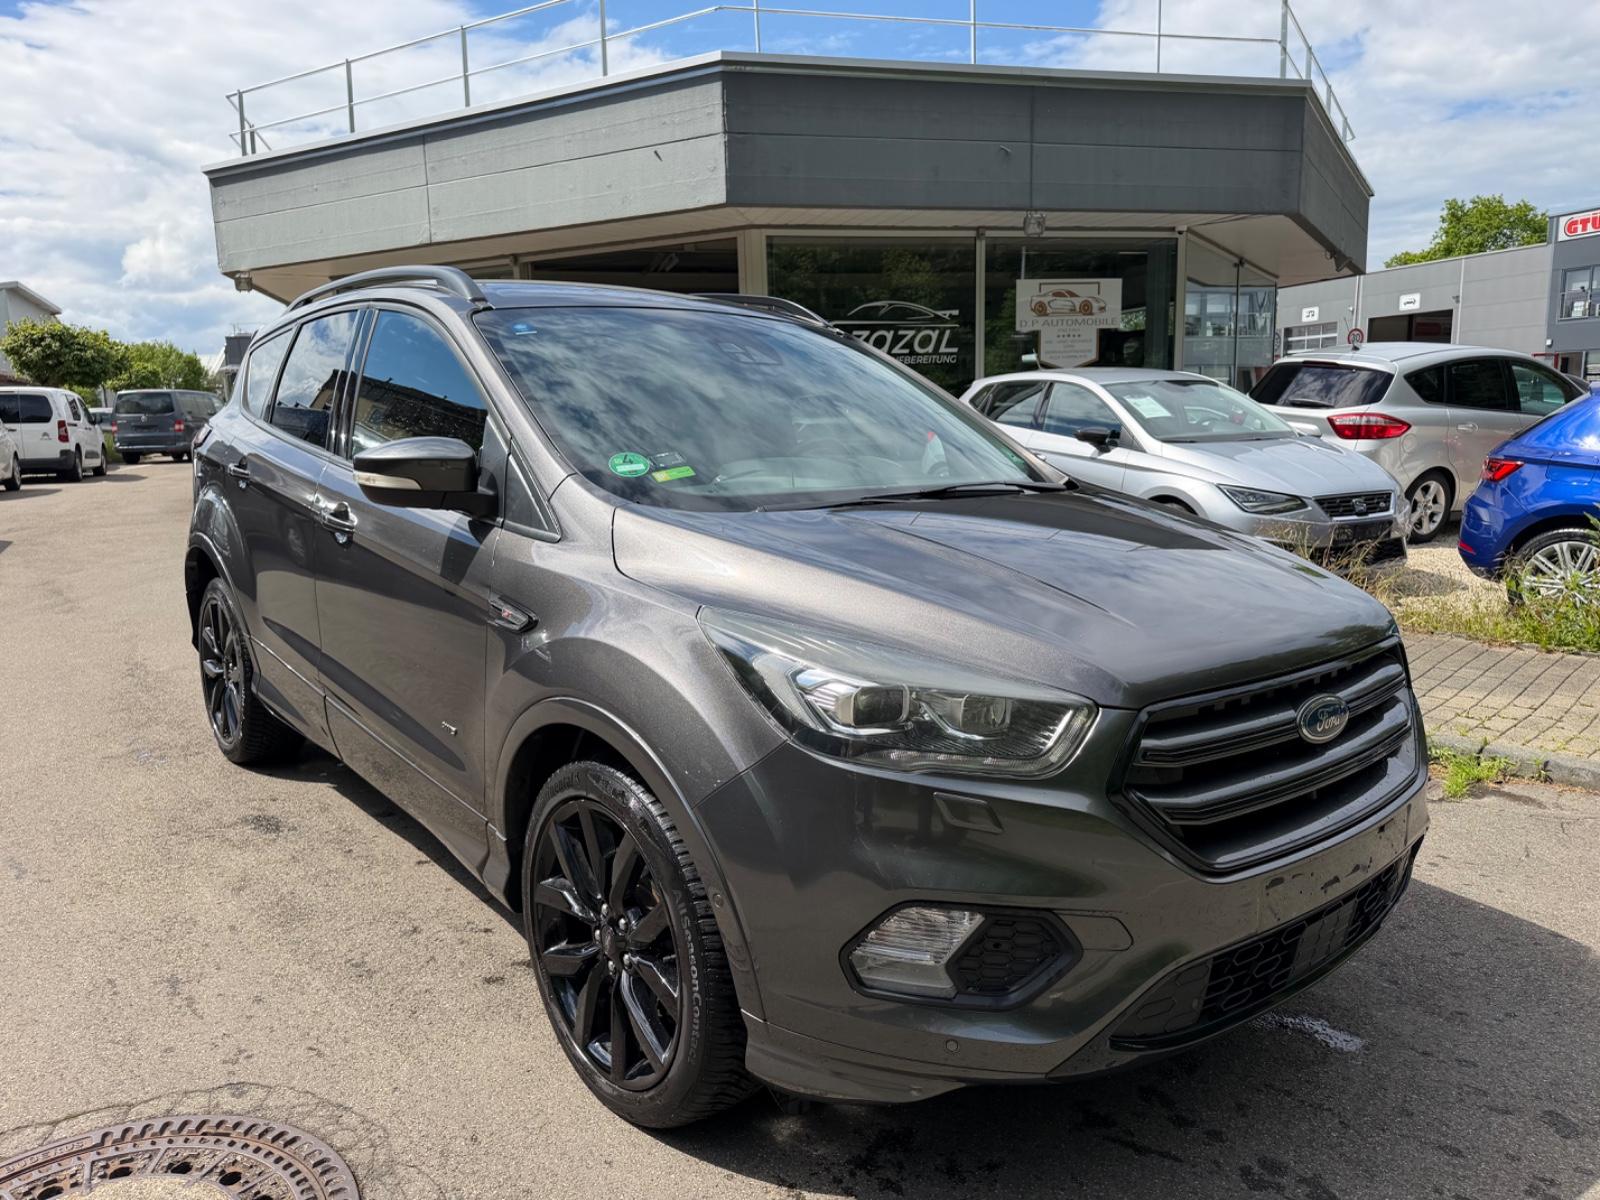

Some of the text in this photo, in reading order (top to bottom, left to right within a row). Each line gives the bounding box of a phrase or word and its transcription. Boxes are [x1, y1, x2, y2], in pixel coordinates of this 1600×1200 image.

[1041, 317, 1118, 328] AUTOMOBILE
[896, 354, 957, 365] FBEREITUNG
[1316, 708, 1344, 732] Ford
